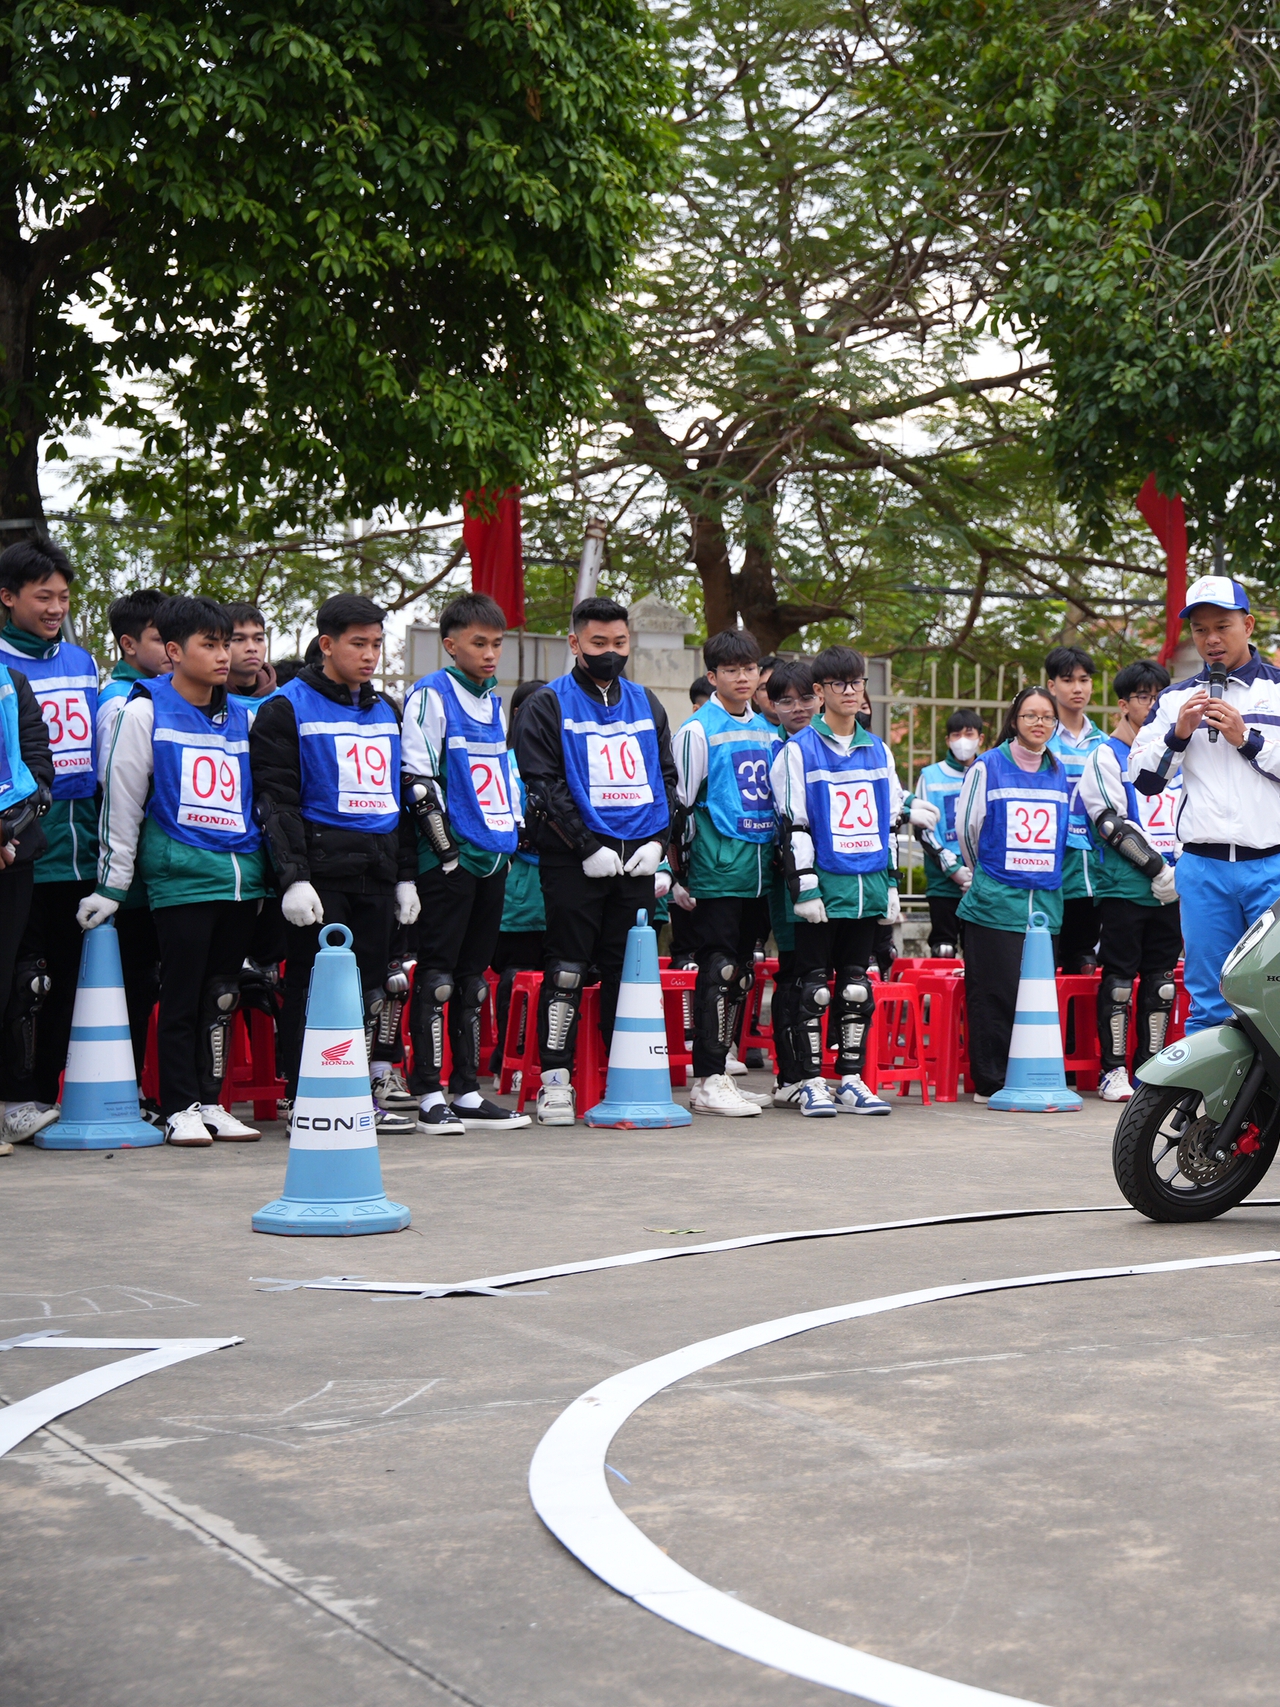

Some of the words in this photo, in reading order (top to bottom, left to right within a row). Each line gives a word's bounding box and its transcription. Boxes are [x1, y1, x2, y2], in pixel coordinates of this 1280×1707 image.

[41, 698, 88, 745] 35
[193, 756, 236, 801] 09
[347, 743, 387, 786] 19
[600, 741, 635, 780] 10
[738, 760, 772, 800] 33
[187, 813, 237, 826] HONDA
[348, 799, 387, 808] HONDA
[836, 789, 873, 828] 23
[1015, 807, 1051, 843] 32
[840, 840, 874, 848] HONDA
[1013, 857, 1050, 866] HONDA
[294, 1116, 354, 1131] ICON
